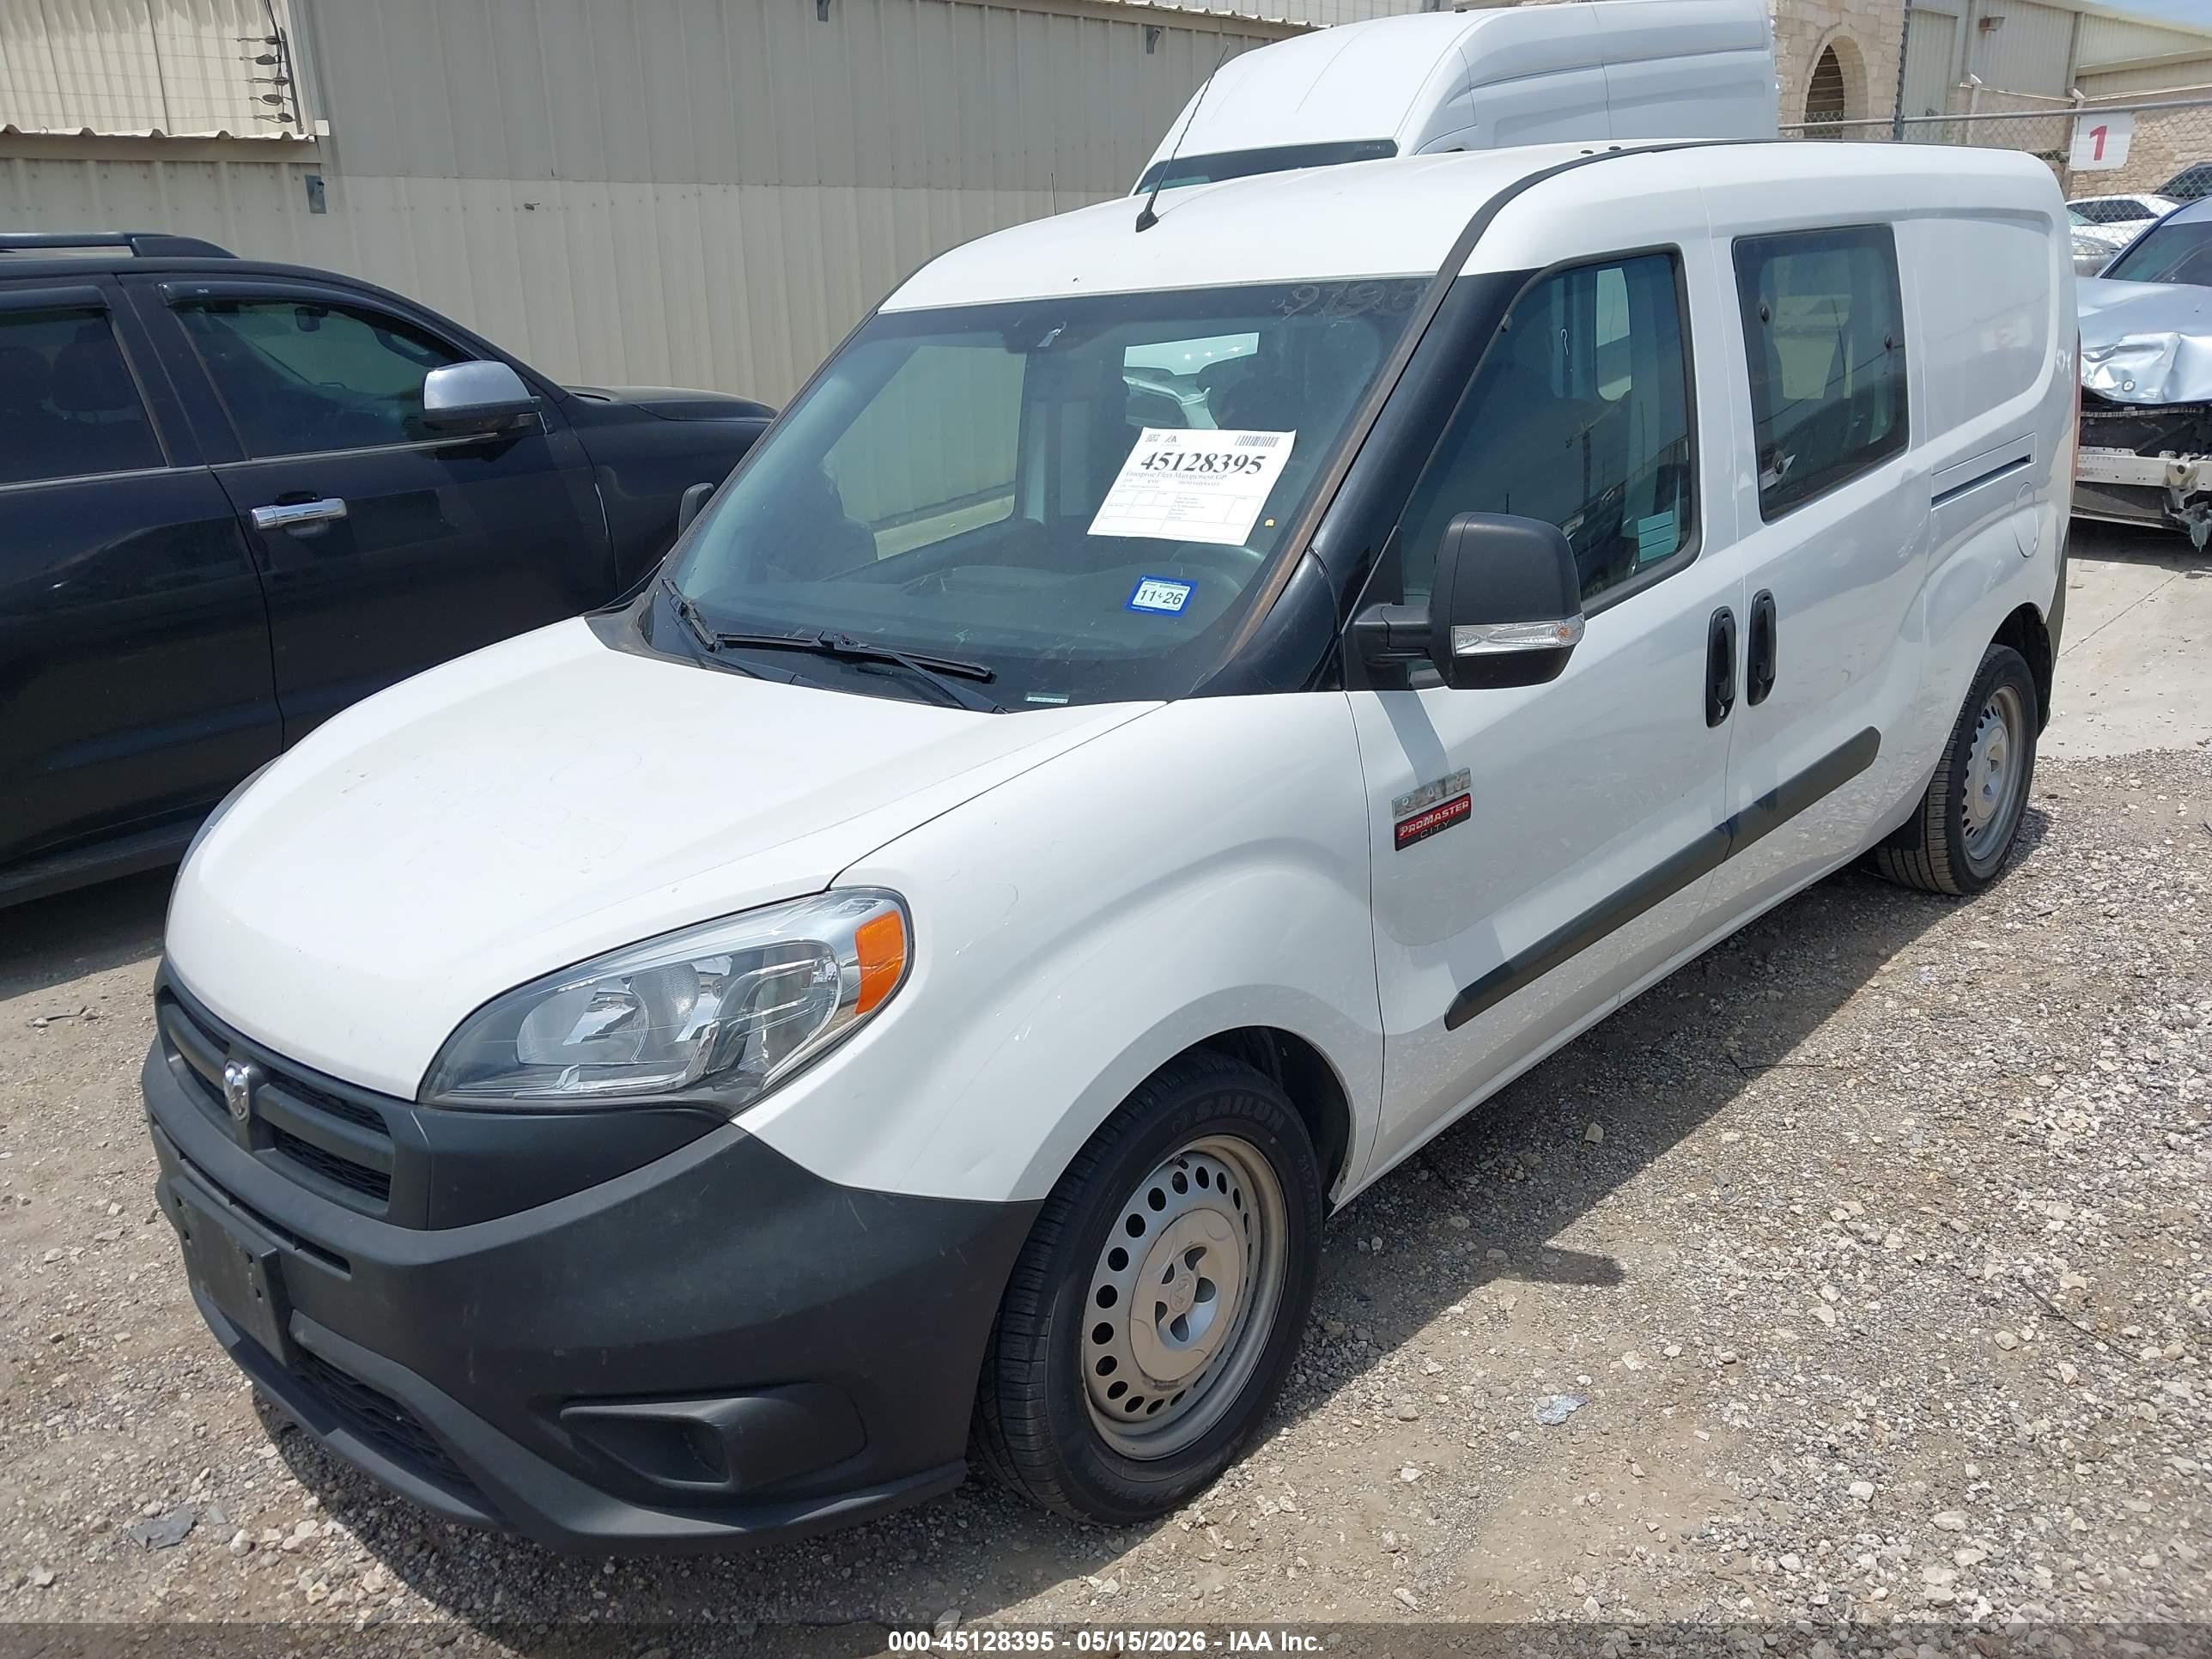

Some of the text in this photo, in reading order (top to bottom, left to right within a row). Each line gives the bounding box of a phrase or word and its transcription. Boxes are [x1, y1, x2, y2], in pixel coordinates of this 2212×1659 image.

[2089, 125, 2107, 161] 1
[1140, 452, 1267, 475] 45128395
[1162, 592, 1183, 605] 26
[1420, 819, 1450, 838] CITY
[1195, 1095, 1285, 1133] SAILUN
